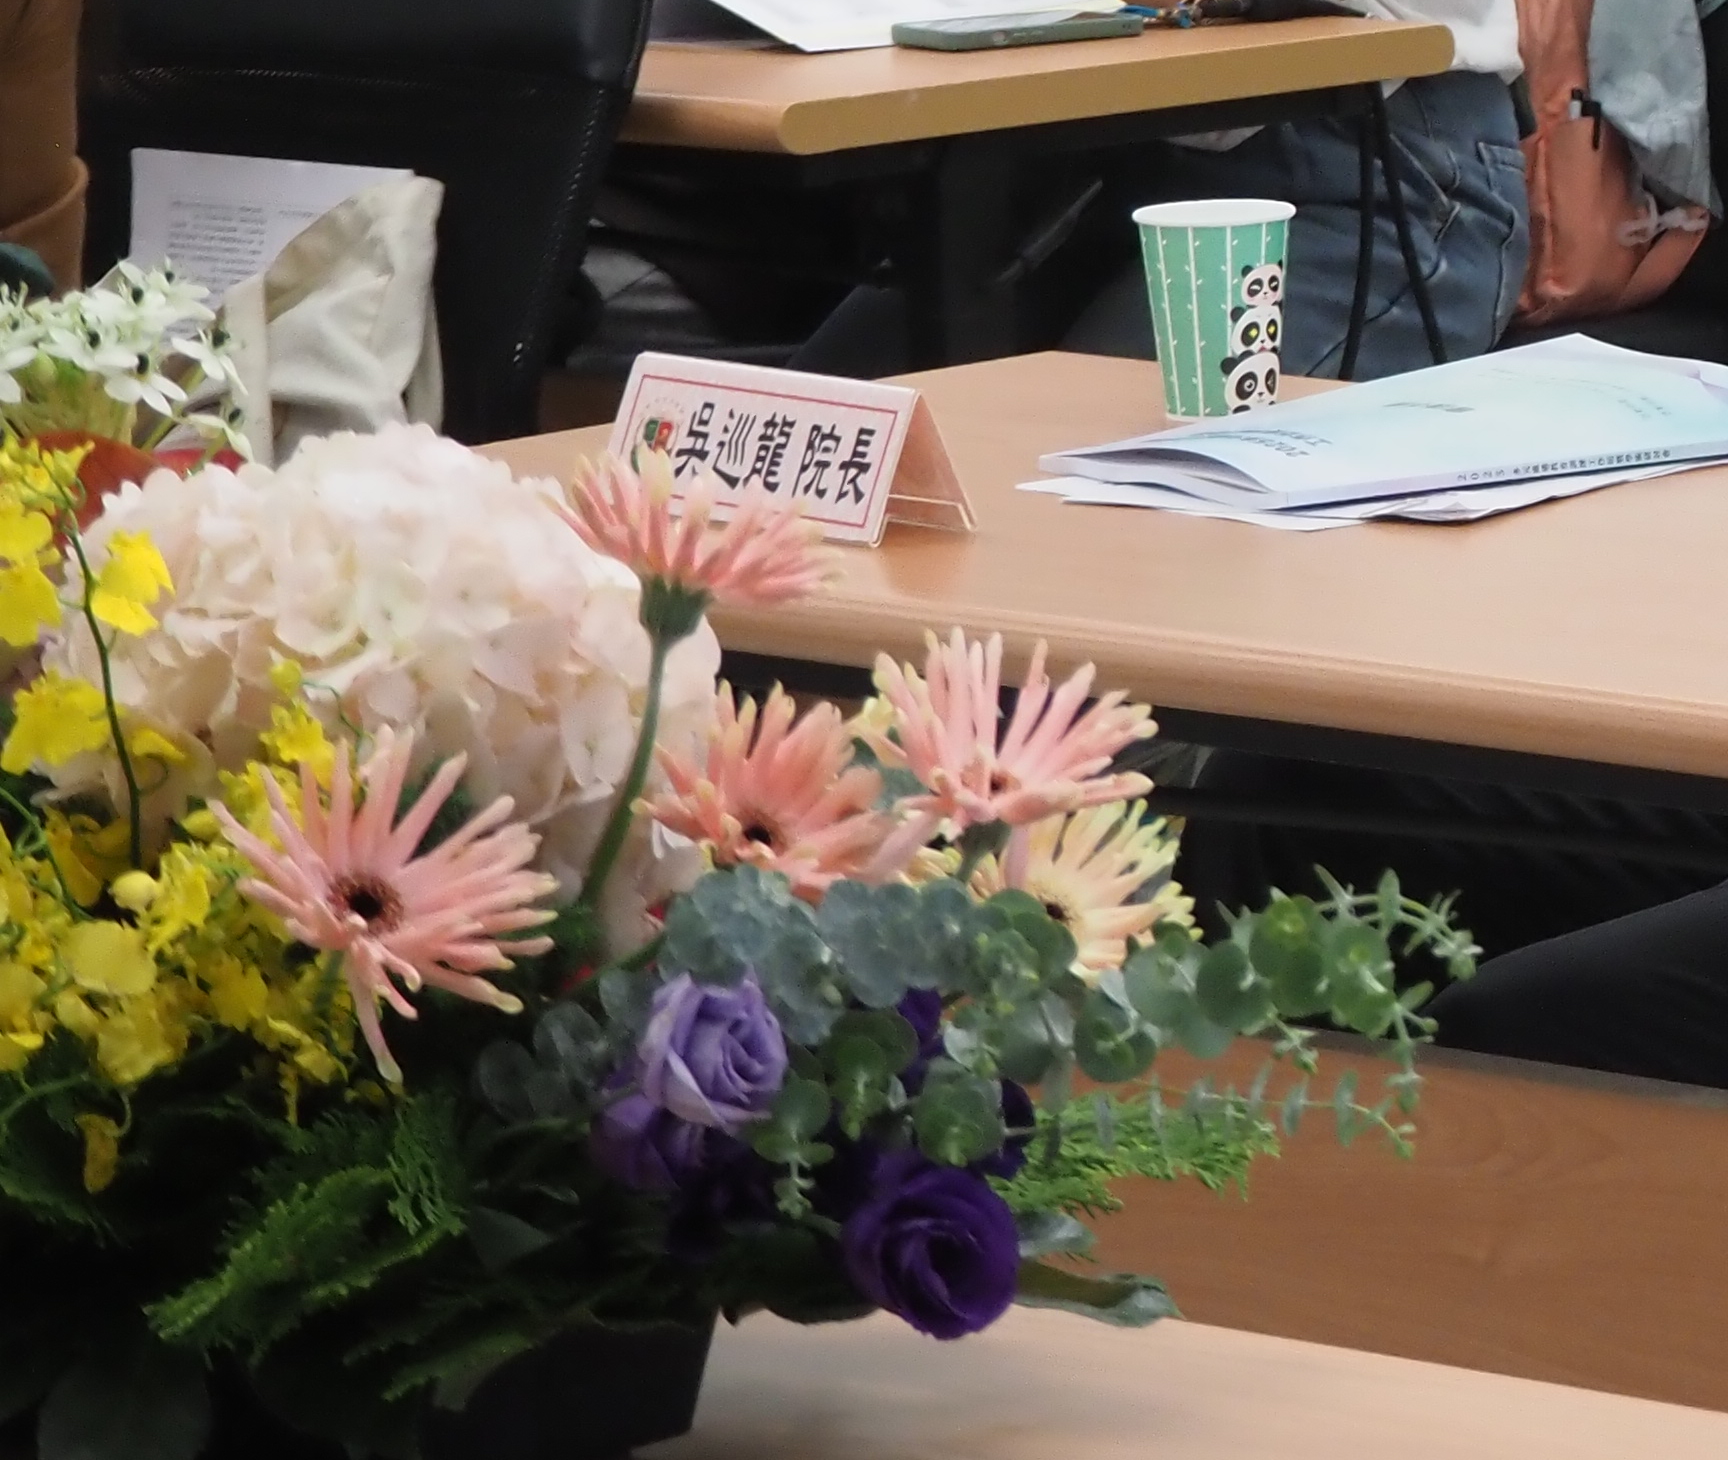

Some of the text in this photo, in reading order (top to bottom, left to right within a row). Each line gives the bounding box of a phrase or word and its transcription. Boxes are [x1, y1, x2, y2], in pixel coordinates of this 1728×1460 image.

[674, 401, 876, 506] 吳巡龍 院長
